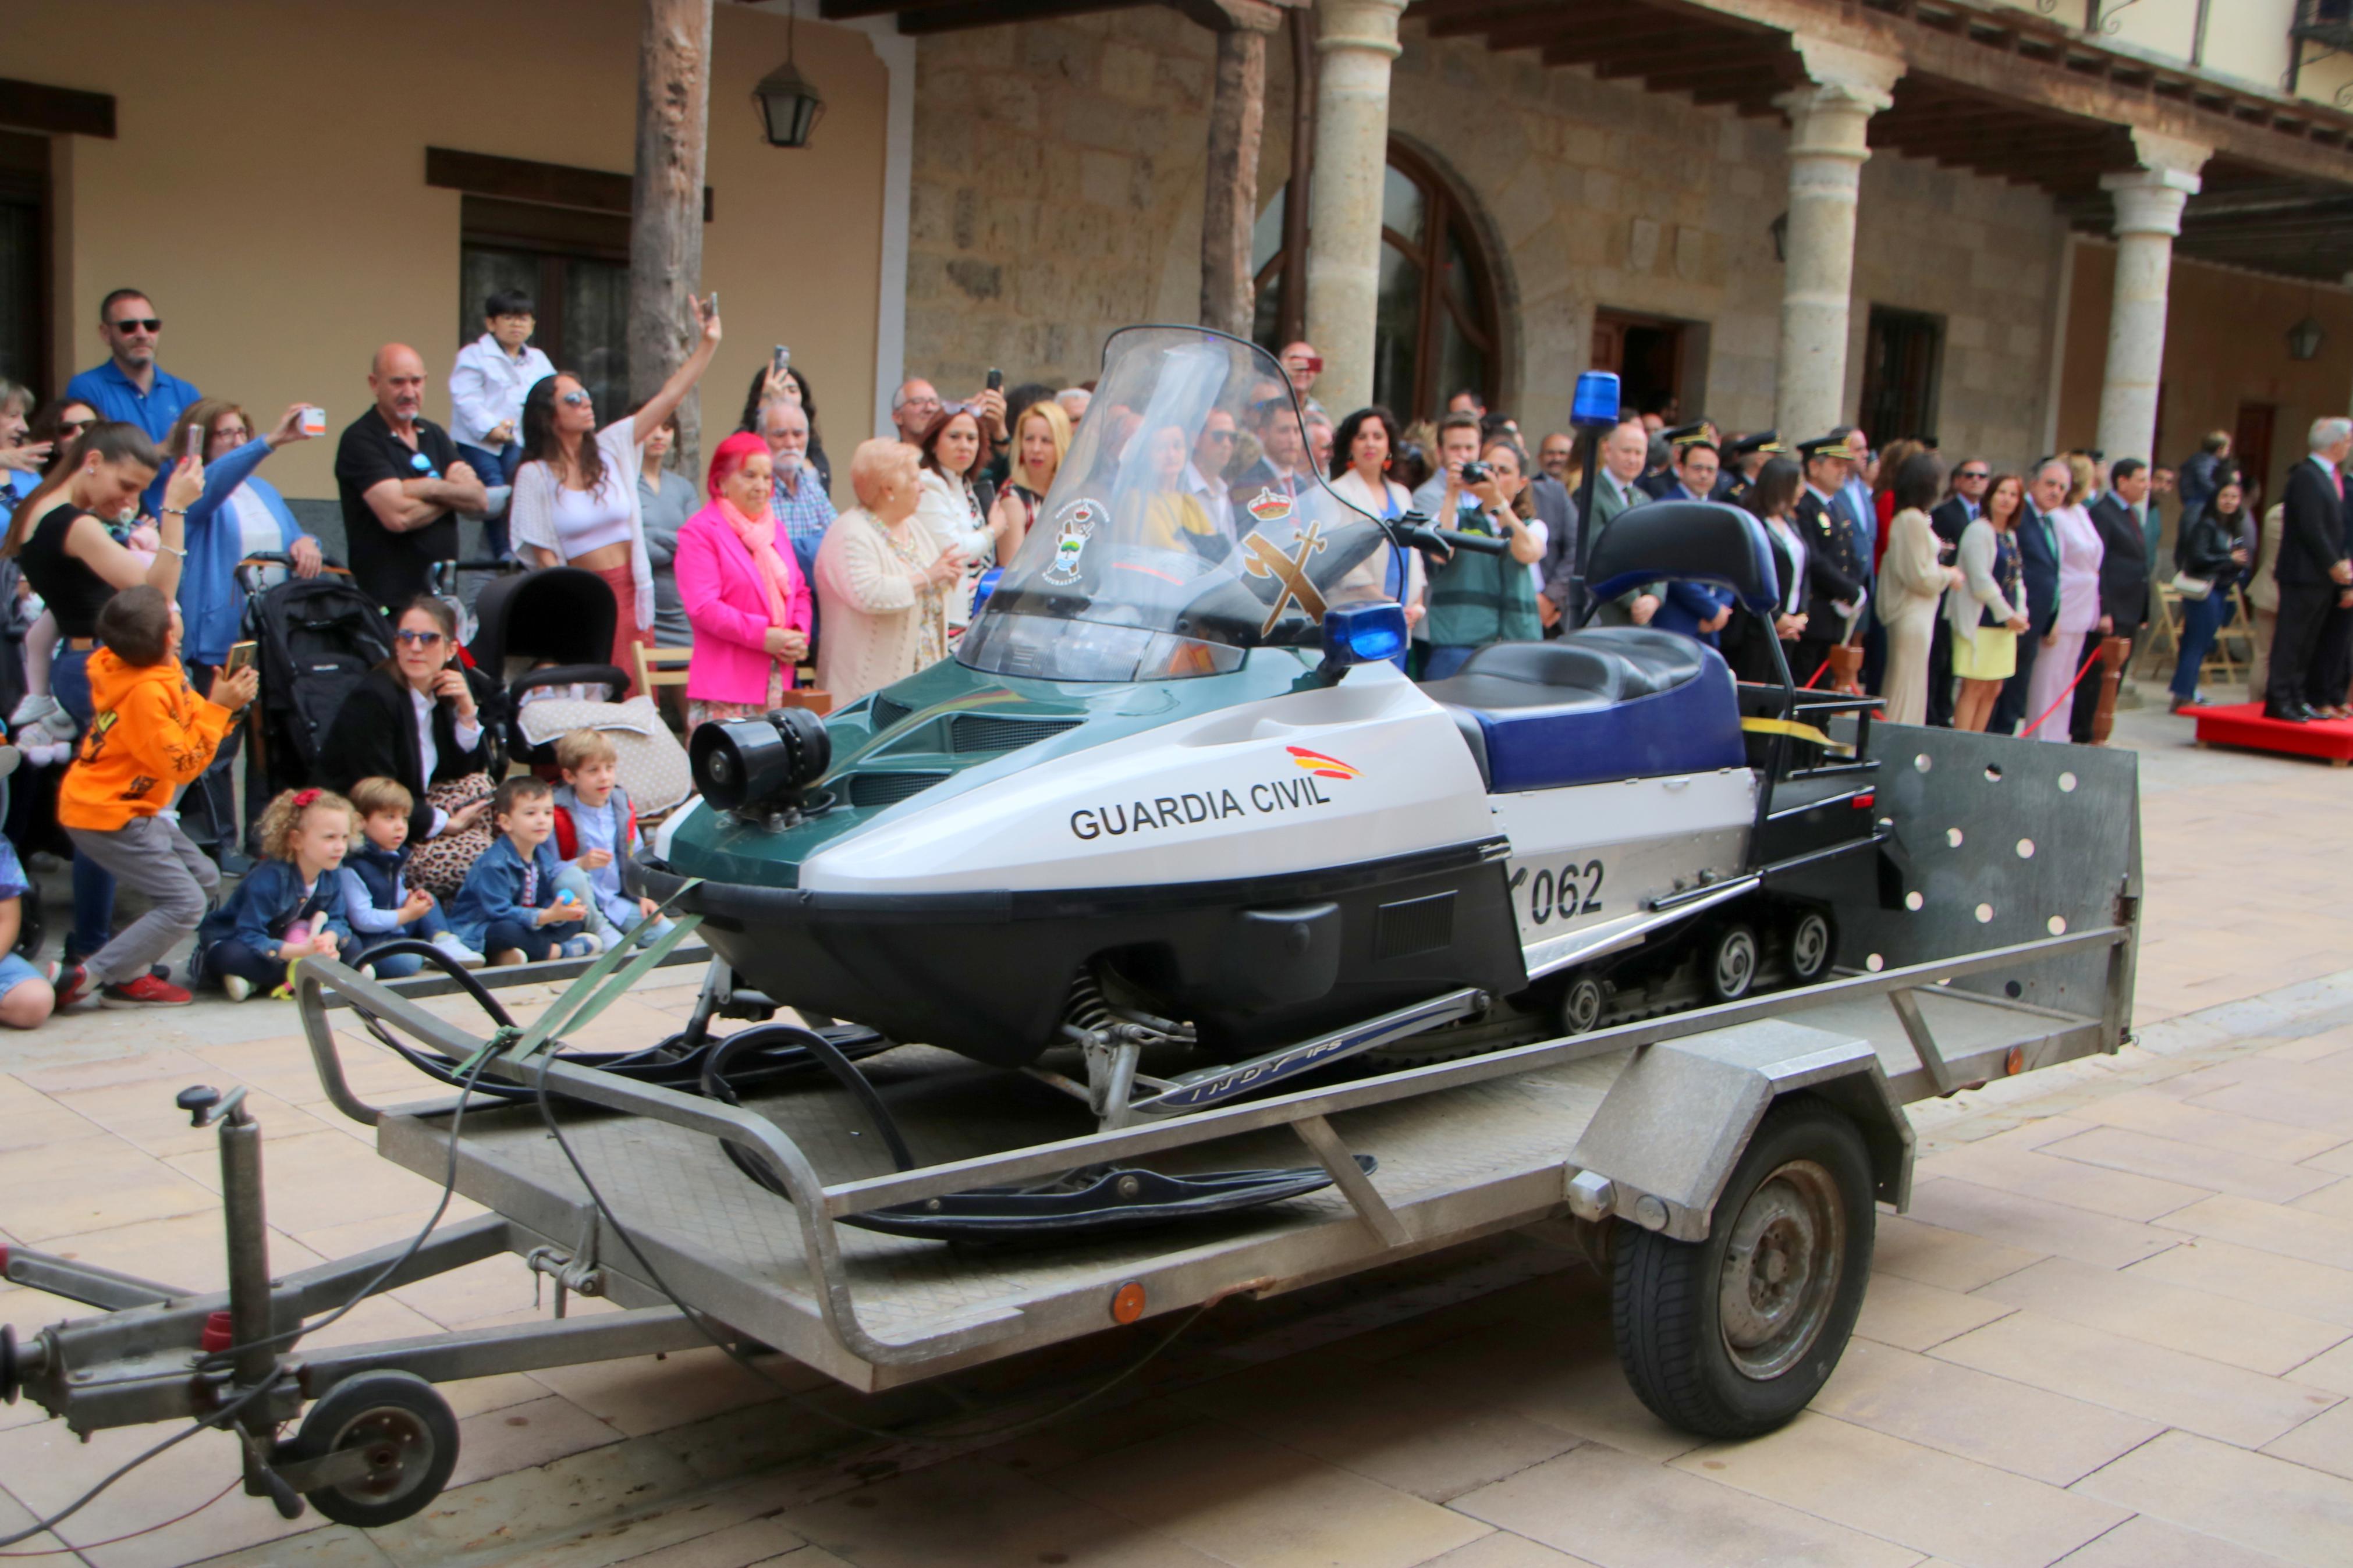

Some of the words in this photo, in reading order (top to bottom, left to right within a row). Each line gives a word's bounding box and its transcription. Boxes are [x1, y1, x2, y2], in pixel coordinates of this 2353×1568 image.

[1070, 788, 1245, 840] GUARDIA
[1250, 776, 1331, 813] CIVIL
[1532, 859, 1604, 925] 062
[1191, 1057, 1289, 1101] INDY
[1306, 1039, 1343, 1059] IFS
